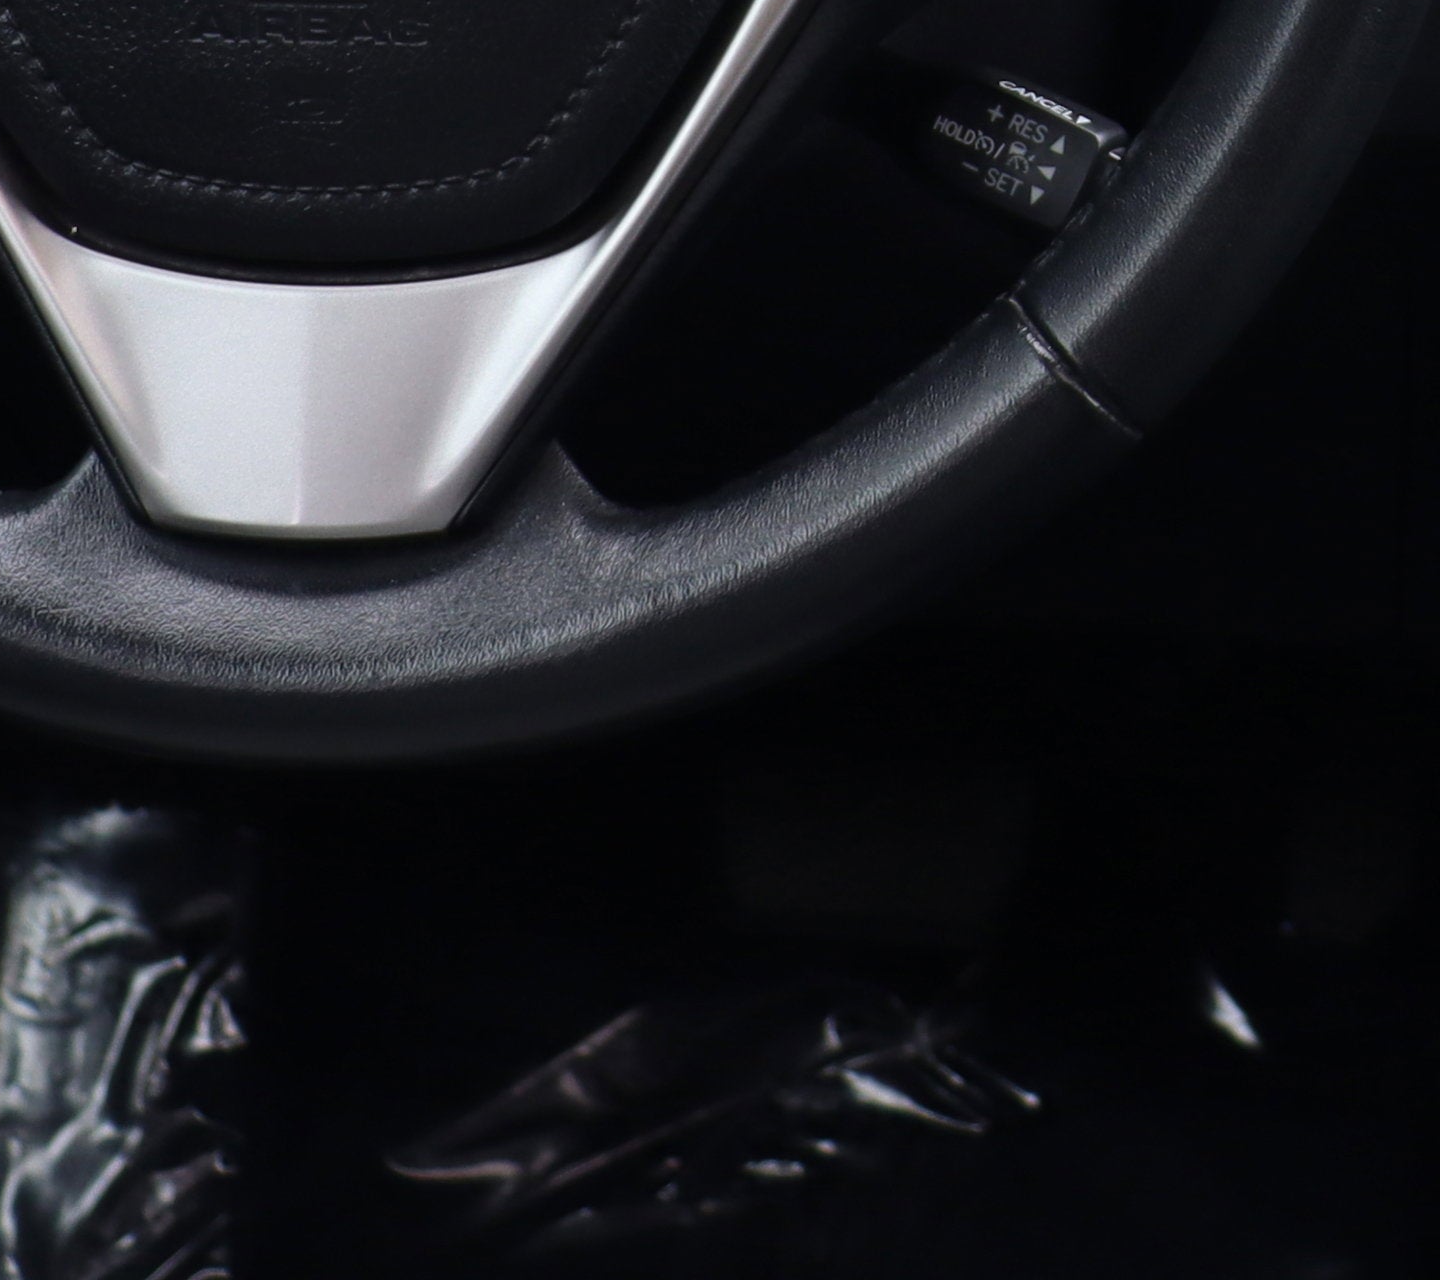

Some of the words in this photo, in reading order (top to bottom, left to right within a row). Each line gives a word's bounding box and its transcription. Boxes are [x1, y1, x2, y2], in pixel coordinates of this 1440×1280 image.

[998, 79, 1074, 121] CANCEL
[932, 114, 978, 146] HOLD
[1008, 113, 1049, 144] RES
[984, 167, 1024, 197] SET
